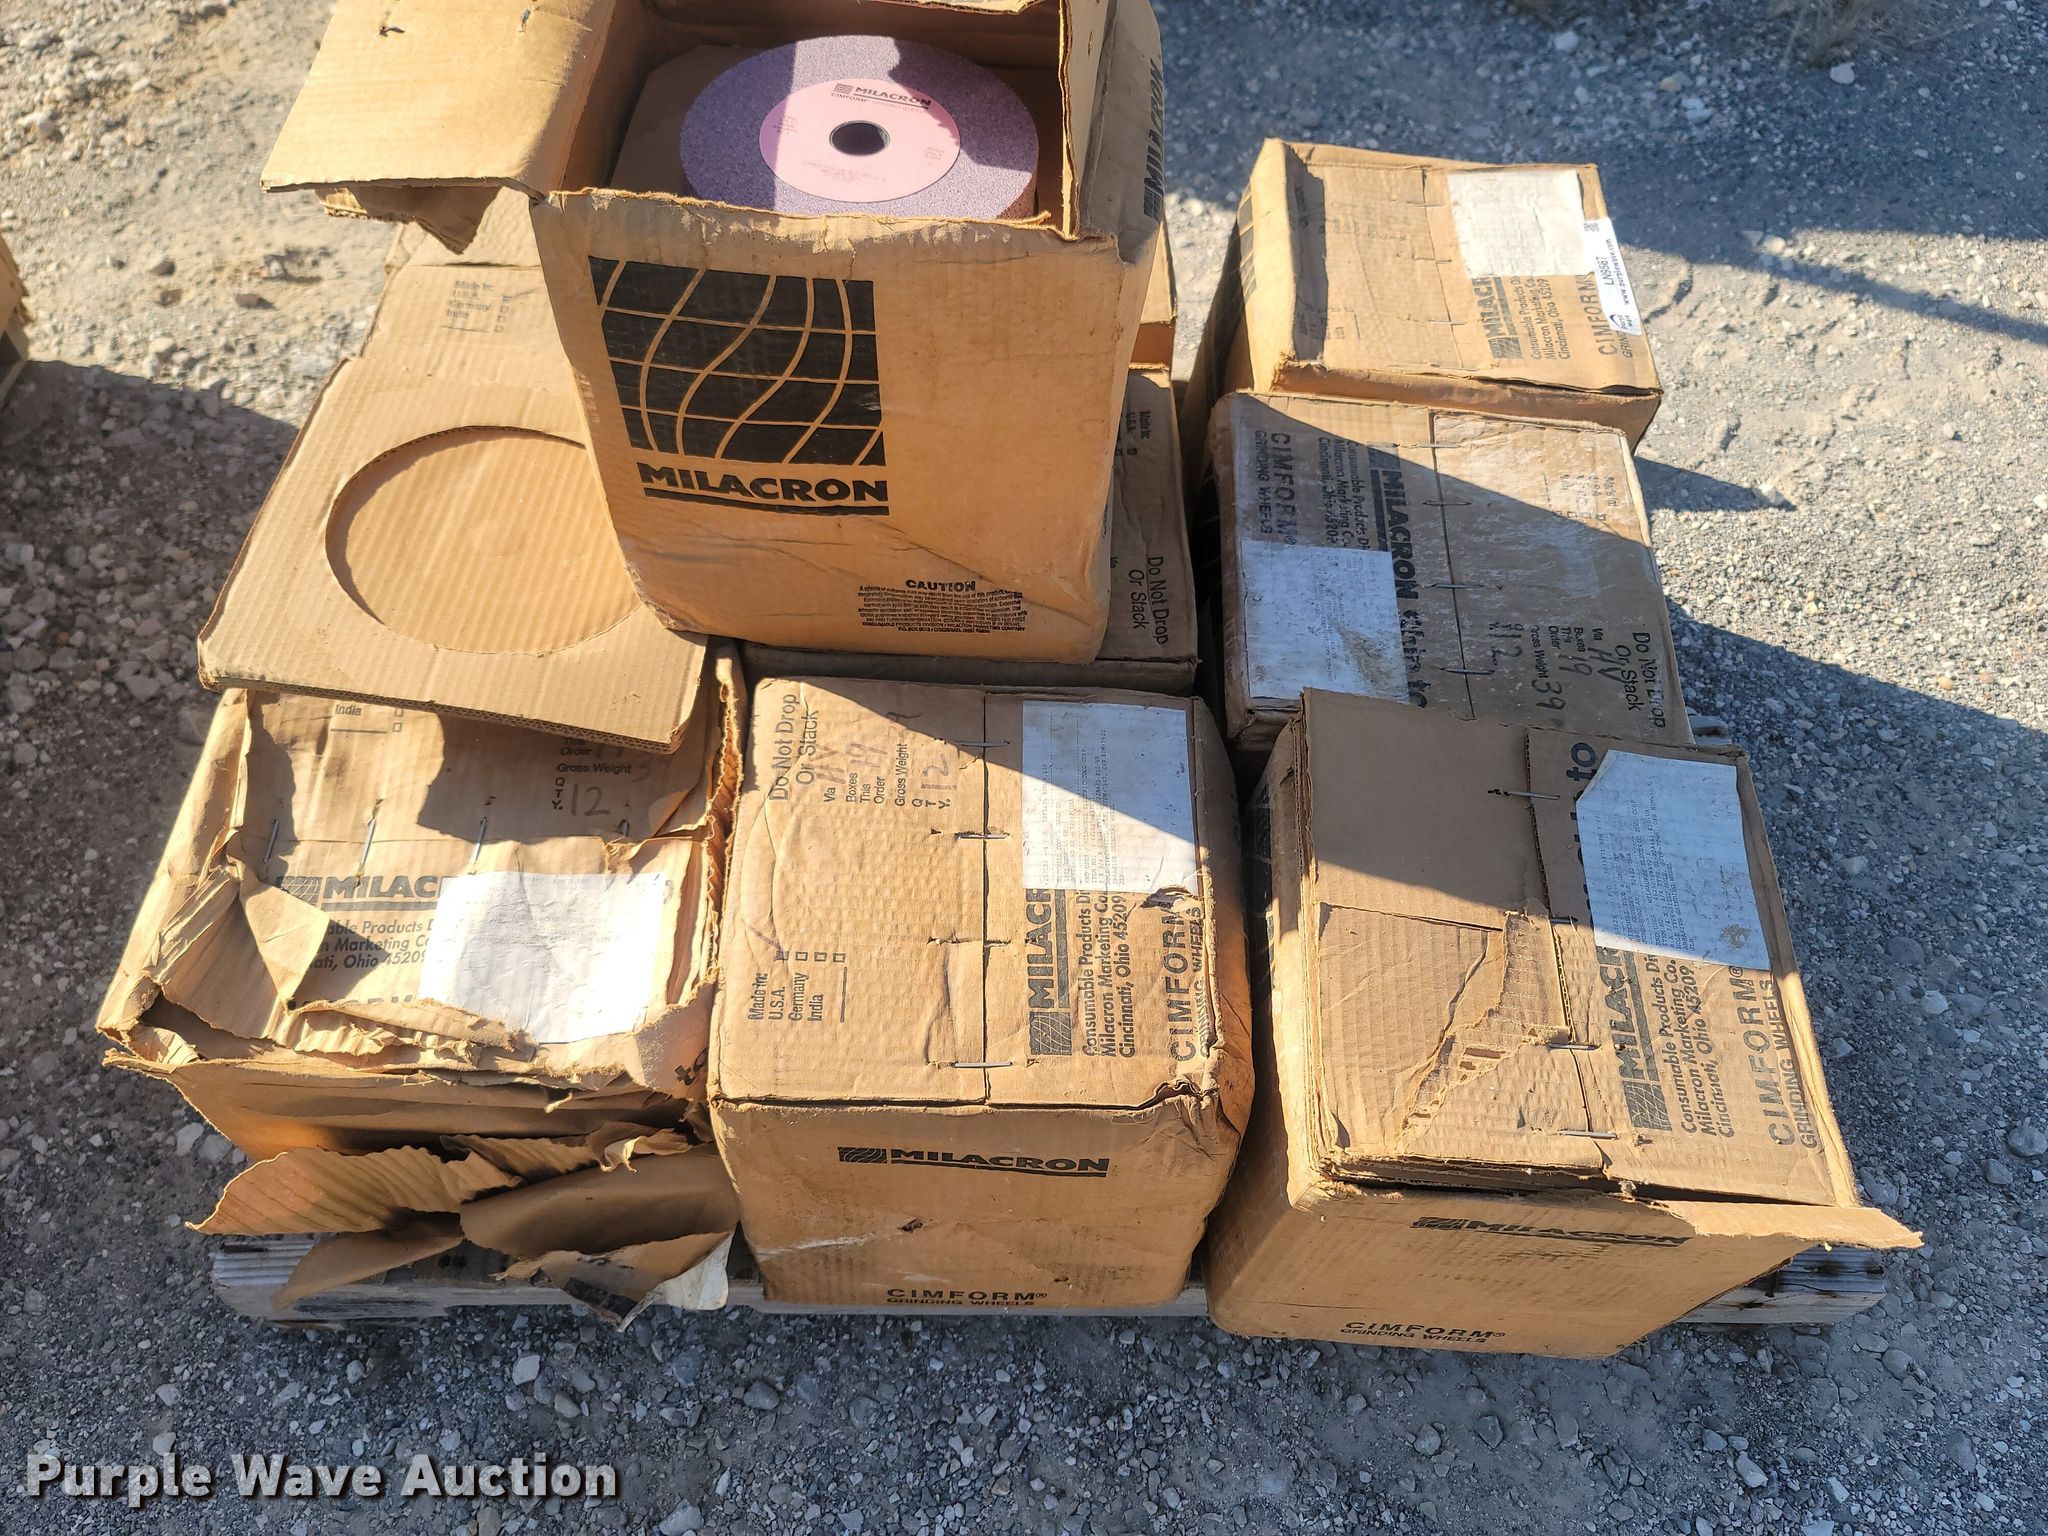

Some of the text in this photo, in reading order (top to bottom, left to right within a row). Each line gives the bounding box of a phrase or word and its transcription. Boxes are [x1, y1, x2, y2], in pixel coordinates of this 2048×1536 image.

[856, 87, 931, 106] MILACRON
[1605, 239, 1631, 306] www.purplewave.com
[1472, 277, 1506, 338] MILACR
[1515, 285, 1530, 315] Products
[1531, 288, 1547, 325] Marketing
[1548, 301, 1560, 318] Ohio
[1520, 316, 1543, 359] Consumable
[1540, 325, 1557, 359] Milacron
[1553, 319, 1571, 359] Cincinnati,
[637, 462, 888, 502] MILACRON
[1382, 470, 1419, 600] MILACRON
[905, 580, 976, 592] CAUTION
[1128, 568, 1150, 630] Or Stack
[1147, 556, 1170, 645] Do Not Drop
[1632, 631, 1651, 653] Do
[1533, 649, 1549, 679] Weight
[1614, 644, 1645, 712] Or Stack
[1638, 658, 1659, 685] Not
[335, 704, 363, 716] India
[561, 747, 593, 756] Order
[769, 693, 798, 802] Do Not Drop
[795, 709, 820, 785] Or Stack
[1566, 741, 1598, 782] to
[556, 763, 590, 773] Gross
[593, 763, 633, 775] Weight
[894, 743, 908, 807] Gross Weight
[570, 783, 611, 817] 12
[823, 787, 837, 803] Via
[846, 772, 859, 804] Boxes
[860, 783, 871, 804] This
[873, 776, 887, 805] Order
[322, 875, 442, 900] MILAC
[336, 936, 410, 952] Marketing
[362, 919, 423, 934] Products
[1076, 907, 1094, 966] Products
[343, 954, 380, 969] Ohio
[1025, 888, 1055, 1009] MILACR
[1095, 916, 1114, 989] Marketing
[1111, 895, 1136, 1058] Cincinnati, Ohio 45209
[748, 989, 766, 1020] Made
[768, 986, 786, 1020] U.S.A.
[788, 971, 810, 1022] Germany
[807, 993, 825, 1022] India
[1077, 968, 1097, 1057] Consumable
[1596, 946, 1646, 1080] MILACR
[1652, 976, 1674, 1038] Products
[1099, 990, 1117, 1058] Milacron
[1664, 959, 1717, 1137] Milacron Marketing Co.
[1679, 965, 1735, 1138] Cincinnati, Ohio 45209
[1760, 979, 1818, 1149] GRINDING WHEELS
[1660, 1041, 1697, 1134] Consumable
[890, 1149, 1110, 1172] MILACRON
[1465, 1220, 1693, 1245] MILACRON
[886, 1298, 1036, 1307] GRINDING WHEELS
[1340, 1328, 1490, 1344] GRINDING WHEELS
